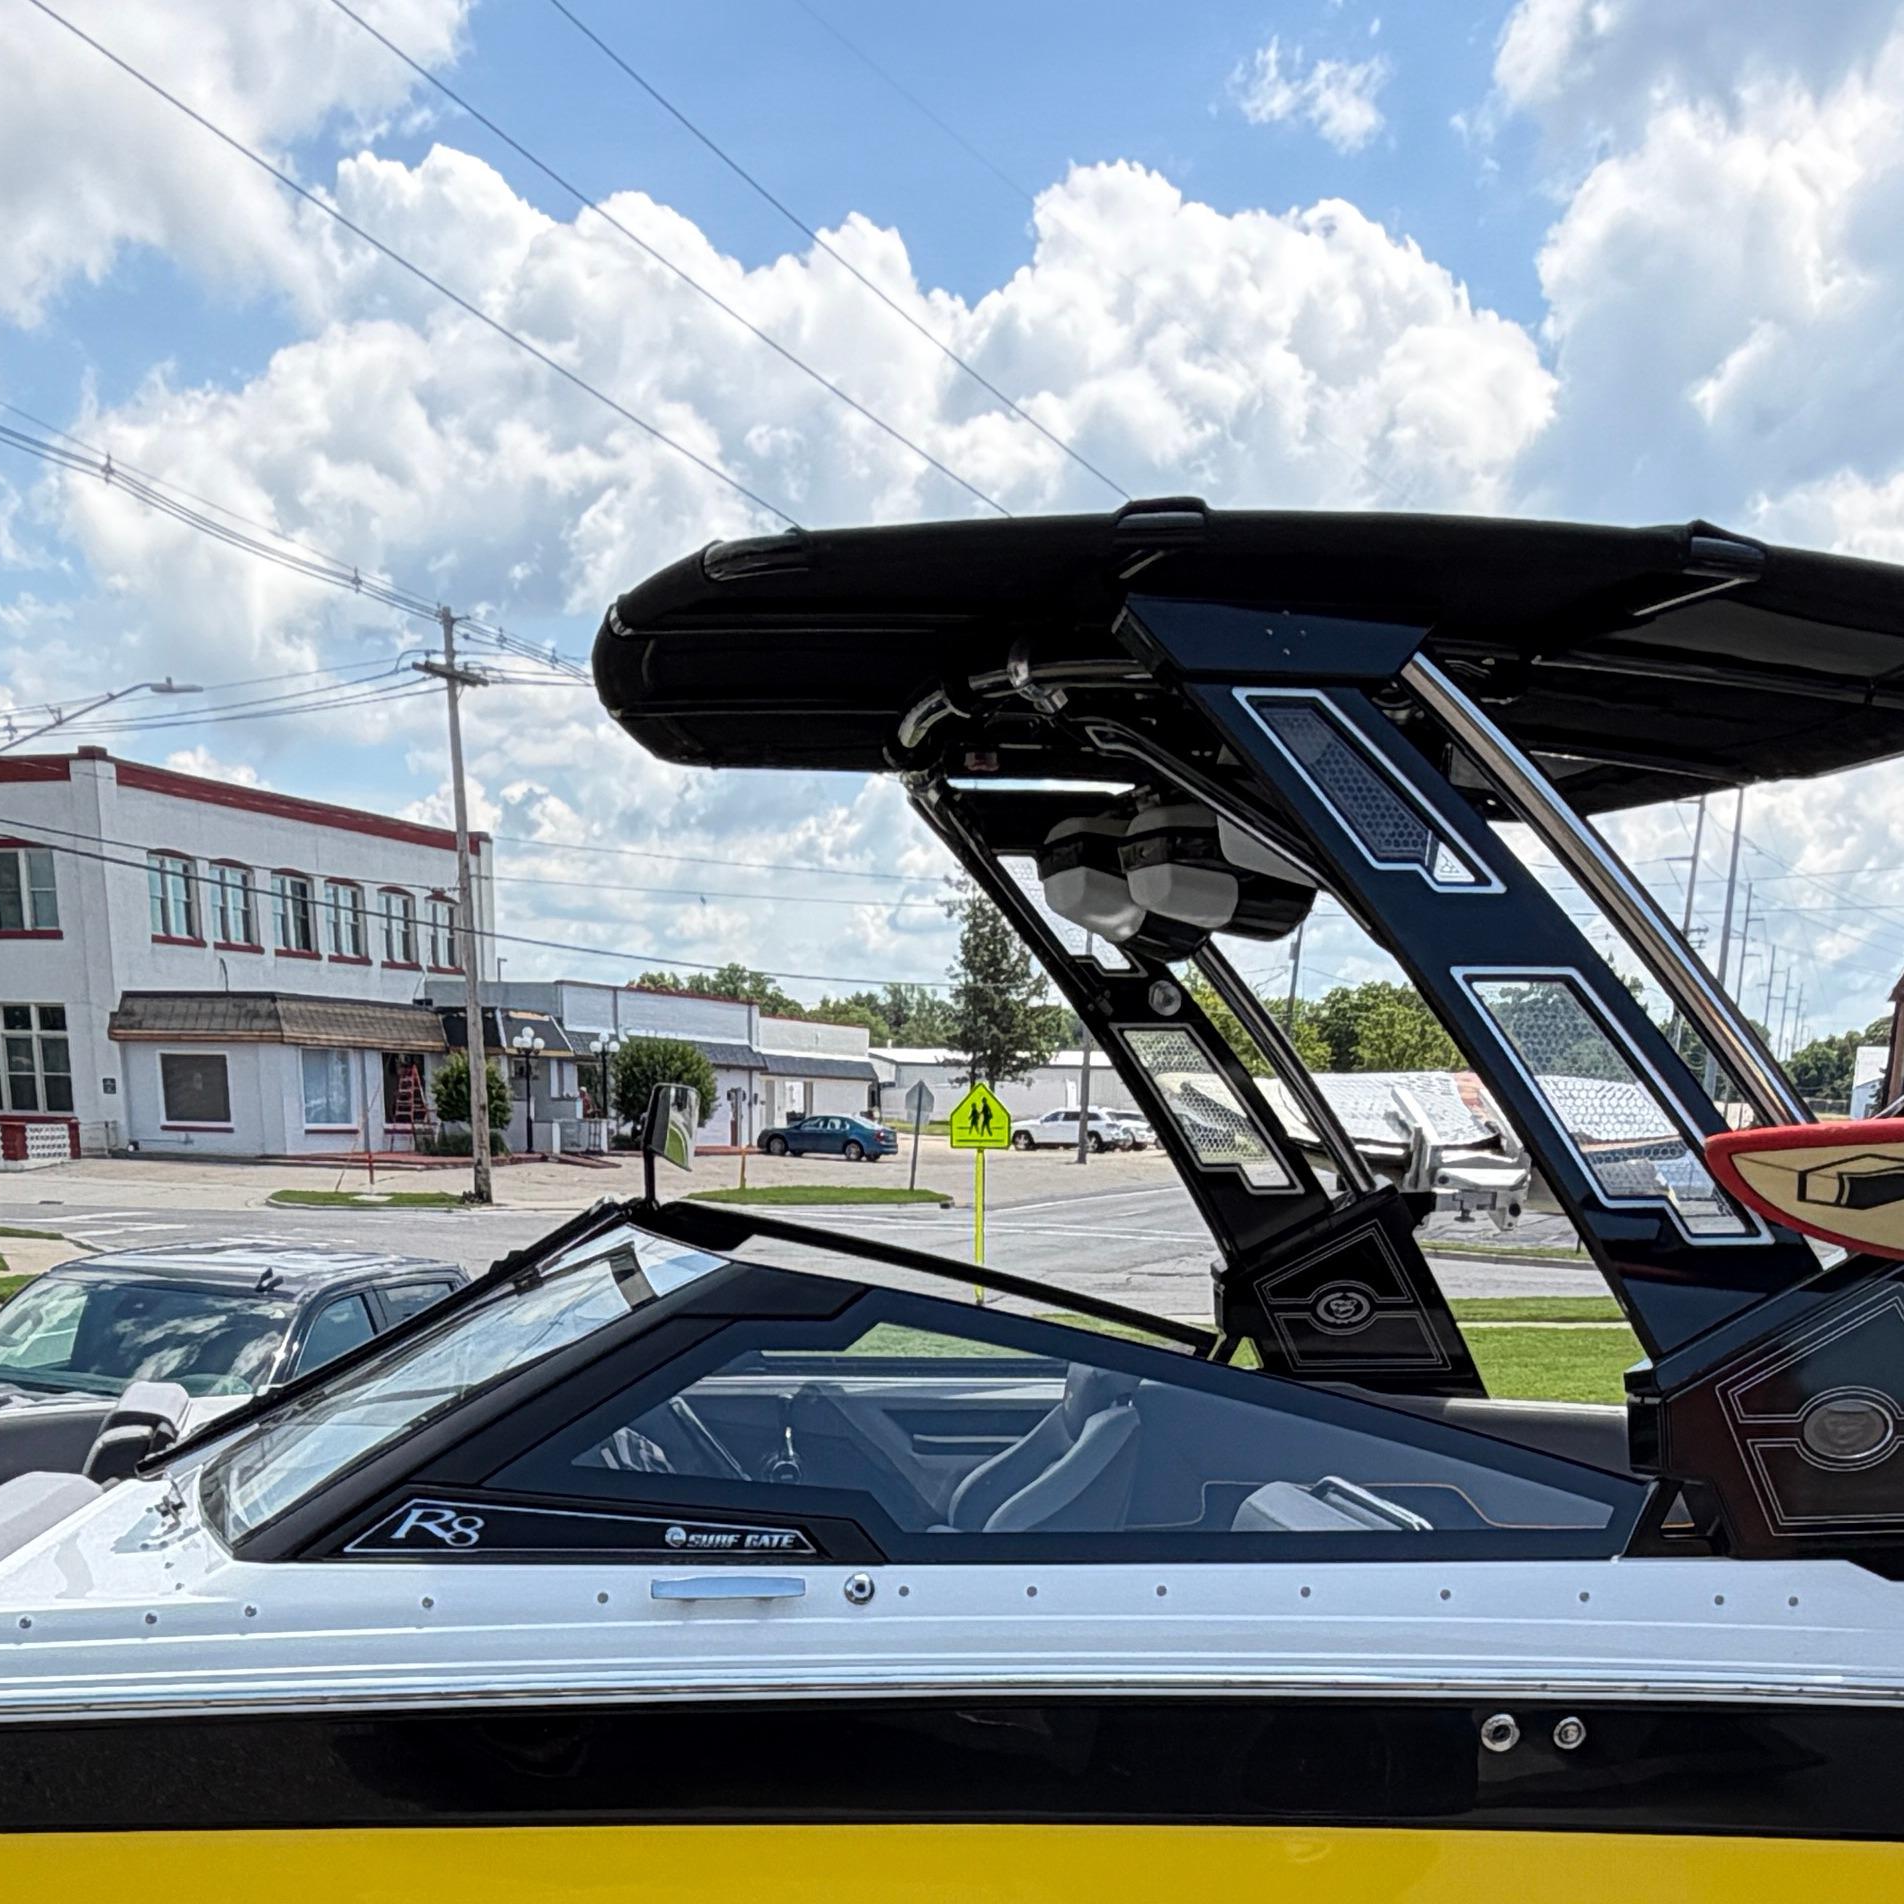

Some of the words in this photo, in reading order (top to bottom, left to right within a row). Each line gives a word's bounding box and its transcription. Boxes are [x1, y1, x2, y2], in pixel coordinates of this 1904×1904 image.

[390, 1508, 485, 1547] R8
[686, 1534, 741, 1548] SURF
[744, 1534, 797, 1548] GATE
